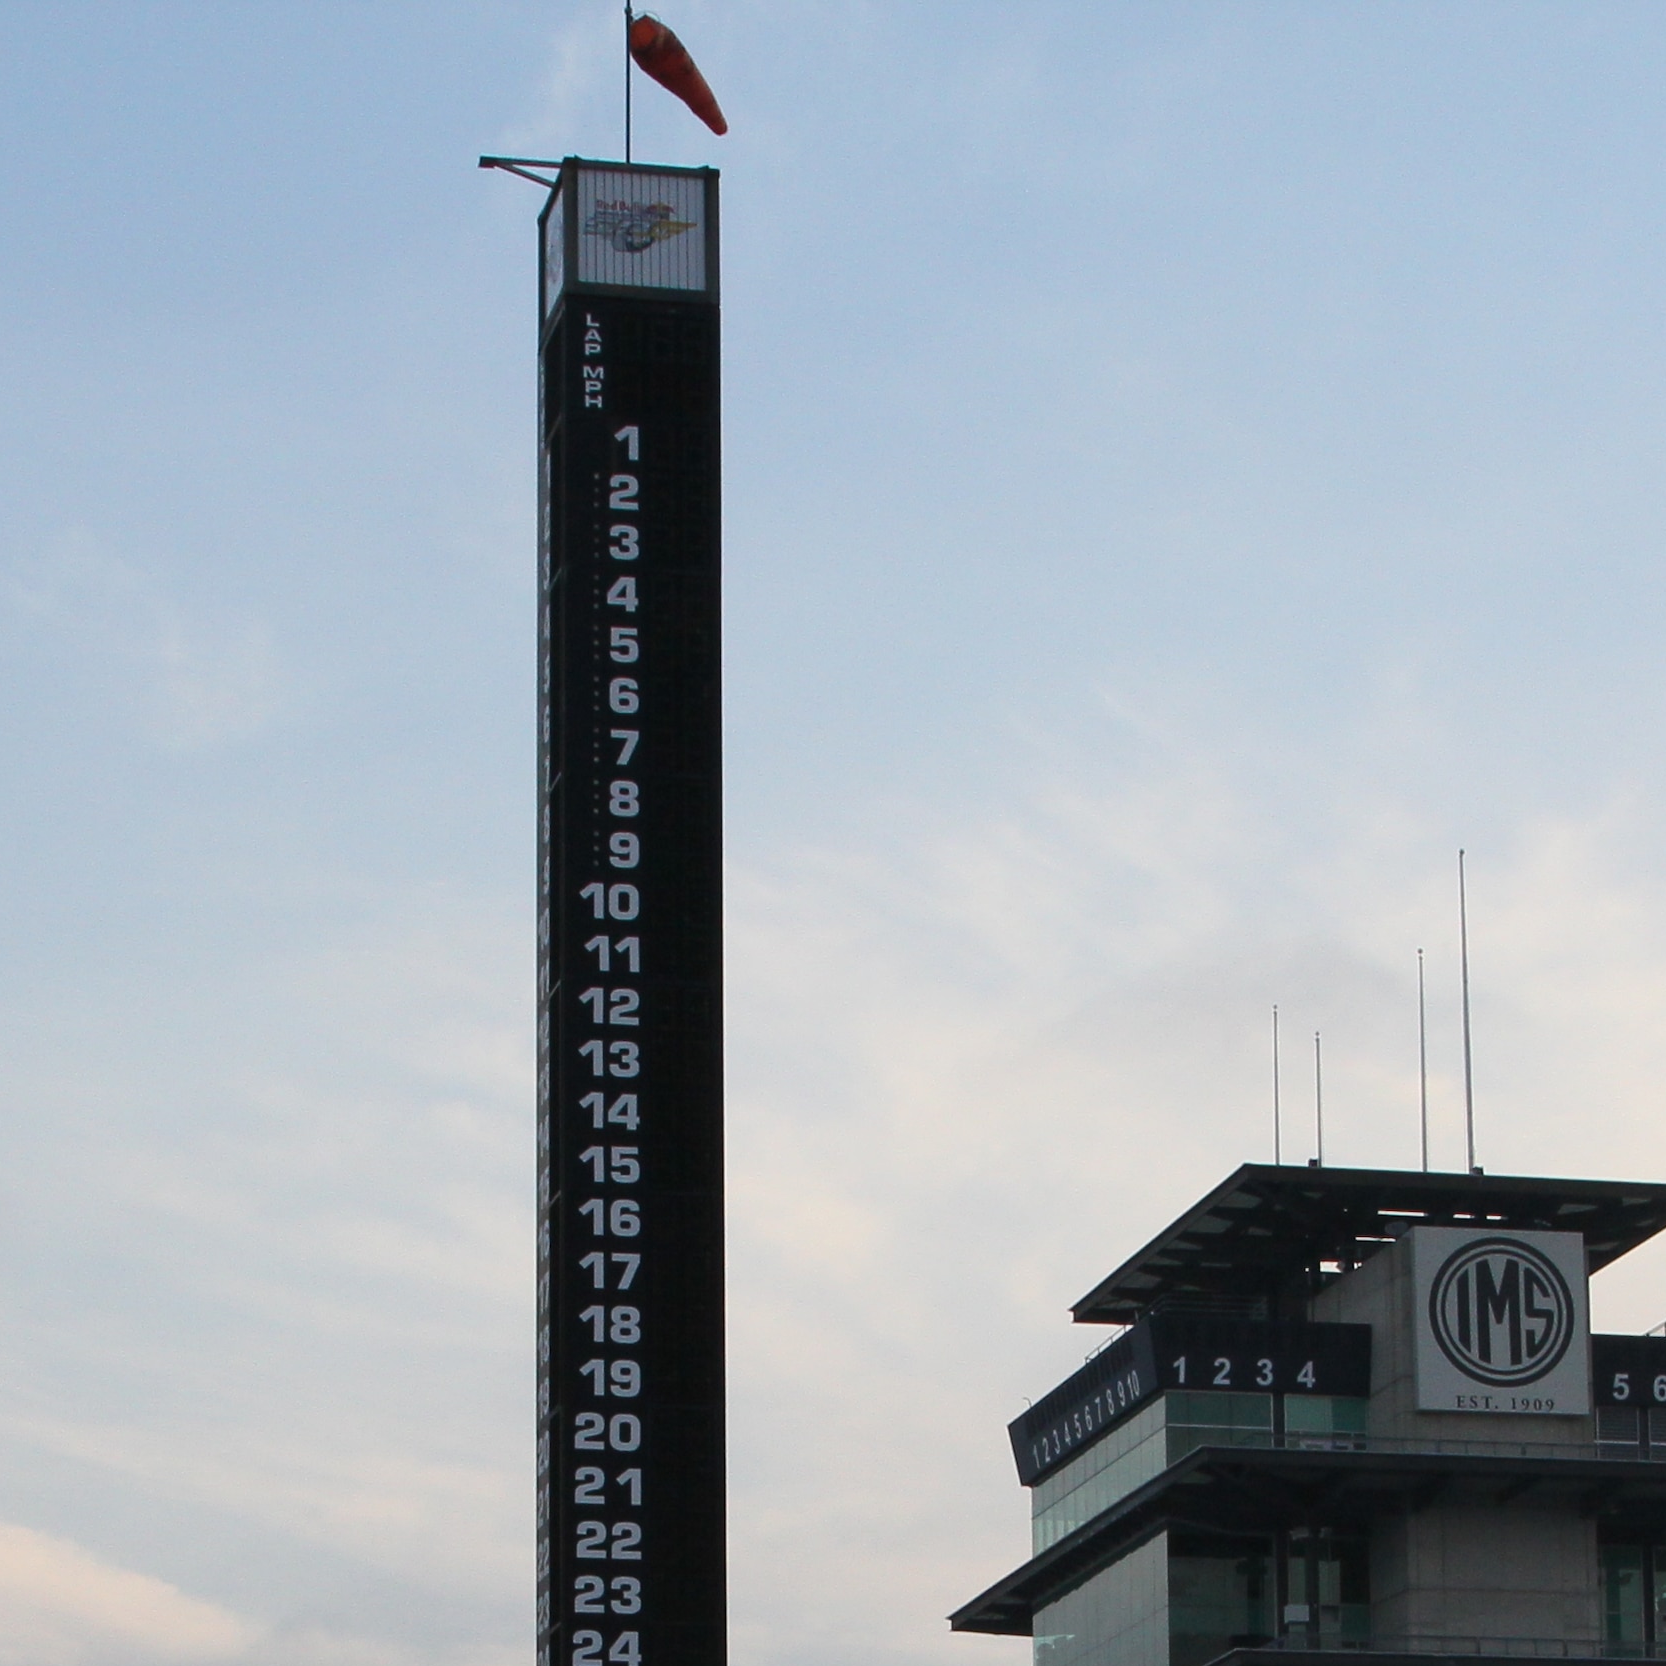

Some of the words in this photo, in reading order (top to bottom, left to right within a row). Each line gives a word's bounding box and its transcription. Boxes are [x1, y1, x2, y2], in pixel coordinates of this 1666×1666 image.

[584, 313, 602, 356] LAP
[583, 366, 604, 408] MPH
[614, 426, 639, 461] 1
[609, 474, 639, 510] 2
[609, 525, 639, 561] 3
[607, 577, 639, 612] 4
[609, 627, 639, 663] 5
[609, 678, 639, 714] 6
[610, 730, 639, 765] 7
[609, 781, 639, 817] 8
[609, 832, 640, 868] 9
[579, 882, 640, 920] 10
[584, 936, 640, 972] 11
[579, 987, 640, 1026] 12
[579, 1040, 640, 1077] 13
[579, 1092, 640, 1130] 14
[579, 1146, 640, 1184] 15
[579, 1199, 641, 1236] 16
[579, 1252, 641, 1290] 17
[579, 1306, 641, 1344] 18
[1456, 1258, 1555, 1366] IMS
[579, 1359, 641, 1397] 19
[1173, 1356, 1186, 1383] 1
[1213, 1357, 1231, 1385] 2
[1256, 1358, 1273, 1386] 3
[1296, 1361, 1316, 1388] 4
[1612, 1373, 1630, 1400] 5
[1033, 1445, 1040, 1469] 1
[1042, 1437, 1051, 1462] 2
[1053, 1429, 1060, 1454] 3
[1064, 1421, 1071, 1446] 4
[1074, 1413, 1082, 1439] 5
[1084, 1405, 1093, 1431] 6
[1094, 1397, 1102, 1423] 7
[1106, 1389, 1114, 1415] 8
[1117, 1381, 1126, 1407] 9
[1127, 1370, 1140, 1400] 10
[1456, 1395, 1499, 1410] EST.
[1511, 1397, 1555, 1411] 1909
[574, 1412, 641, 1451] 20
[574, 1467, 642, 1505] 21
[576, 1521, 642, 1560] 22
[574, 1576, 642, 1614] 23
